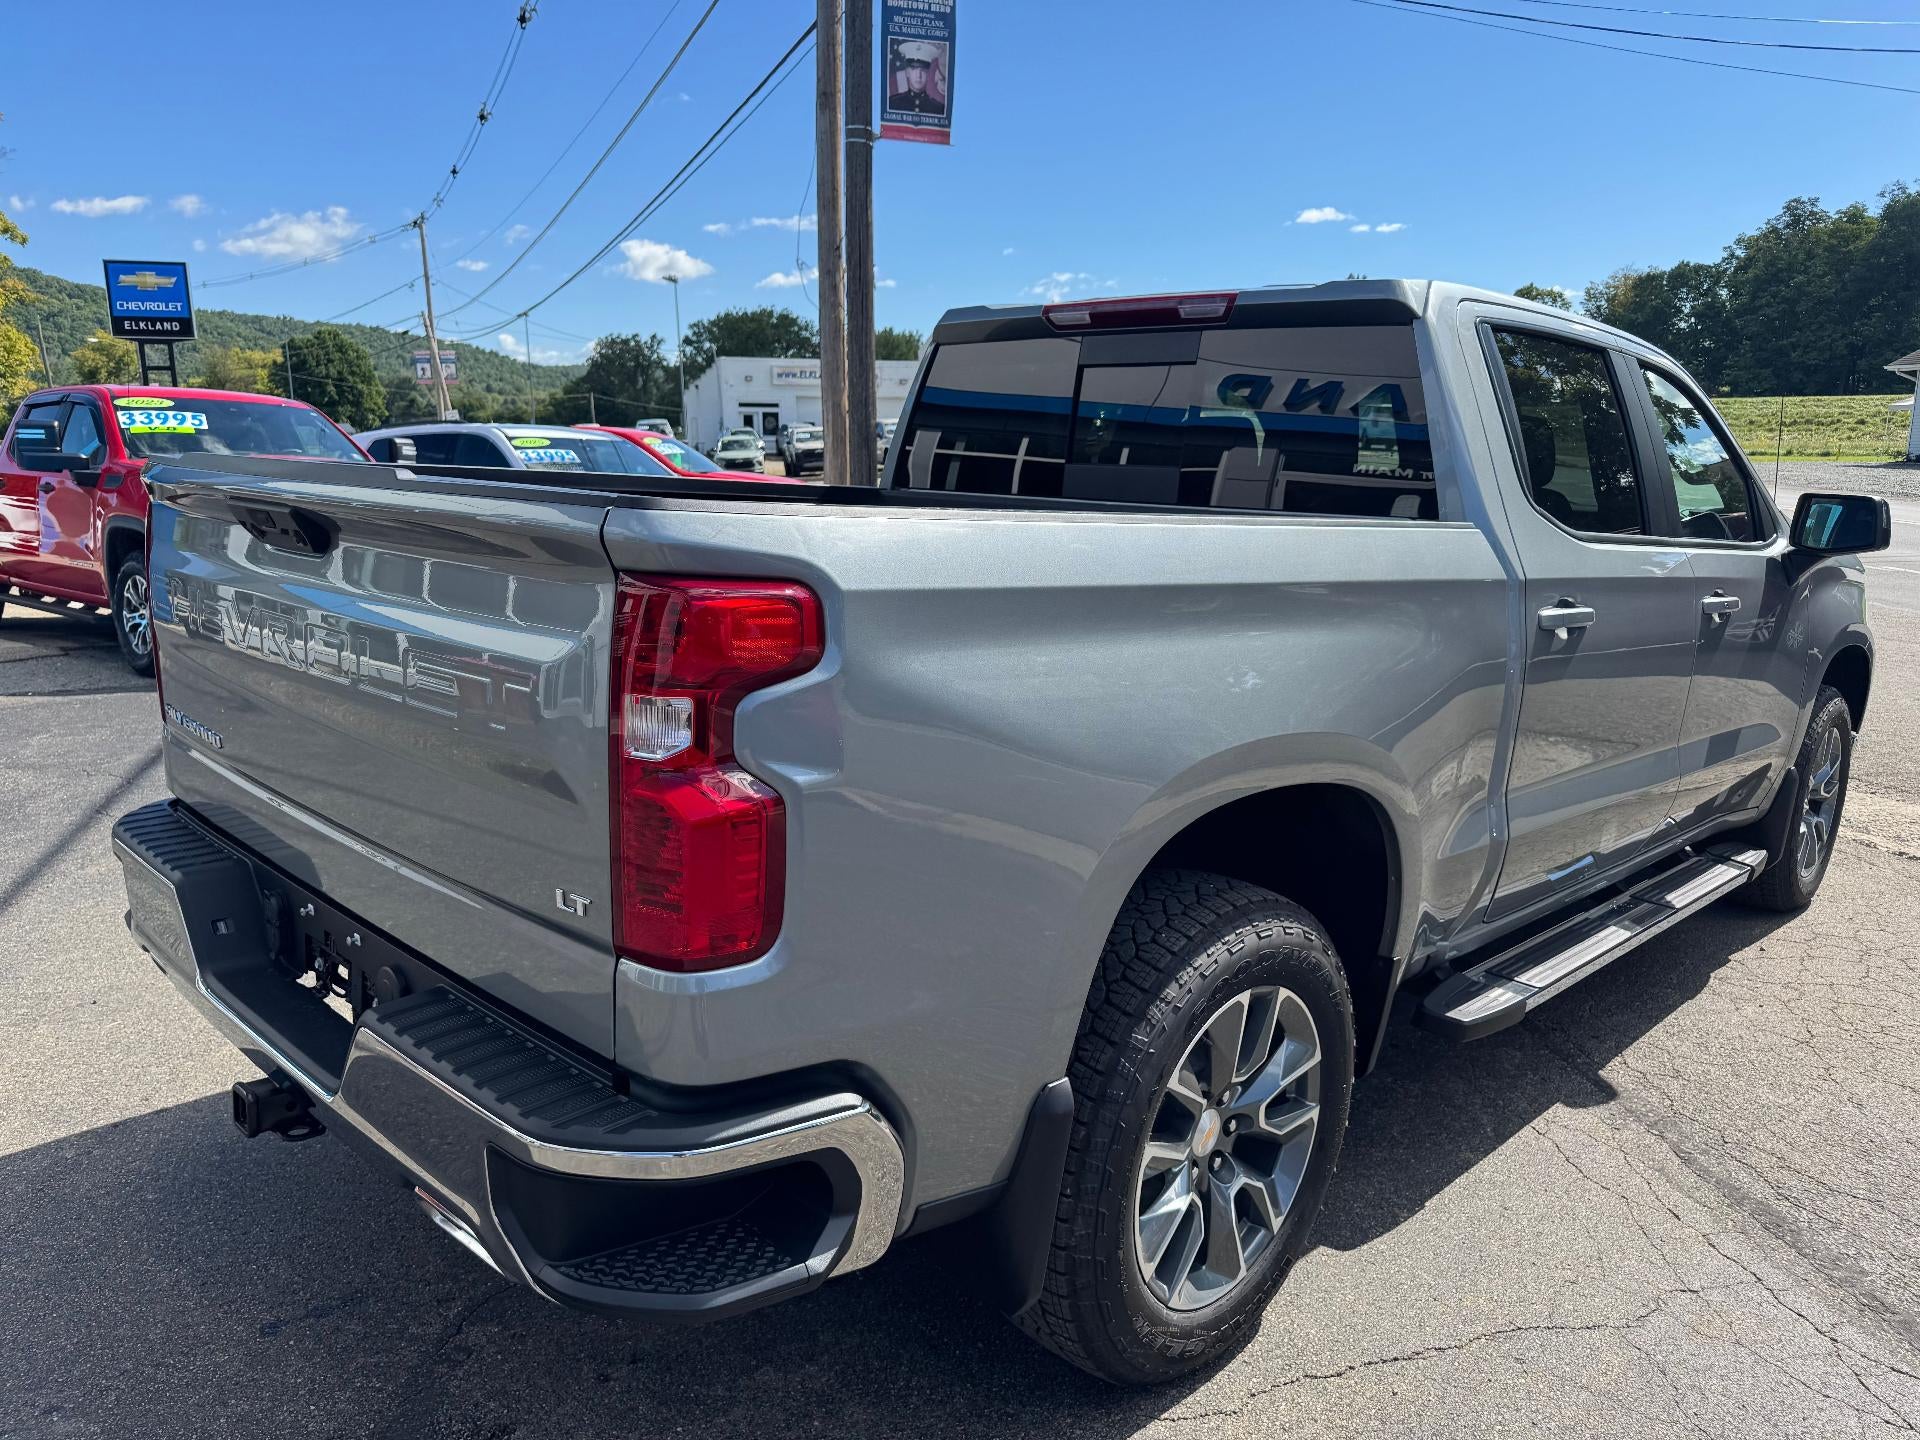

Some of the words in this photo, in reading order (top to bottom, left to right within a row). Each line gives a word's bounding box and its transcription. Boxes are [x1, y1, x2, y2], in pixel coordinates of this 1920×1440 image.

[931, 3, 951, 13] HERO
[902, 26, 927, 35] MARINE
[116, 301, 183, 312] CHEVROLET
[124, 320, 181, 331] ELKLAND
[120, 411, 205, 427] 33995
[519, 450, 576, 462] 33995
[555, 888, 592, 917] LT
